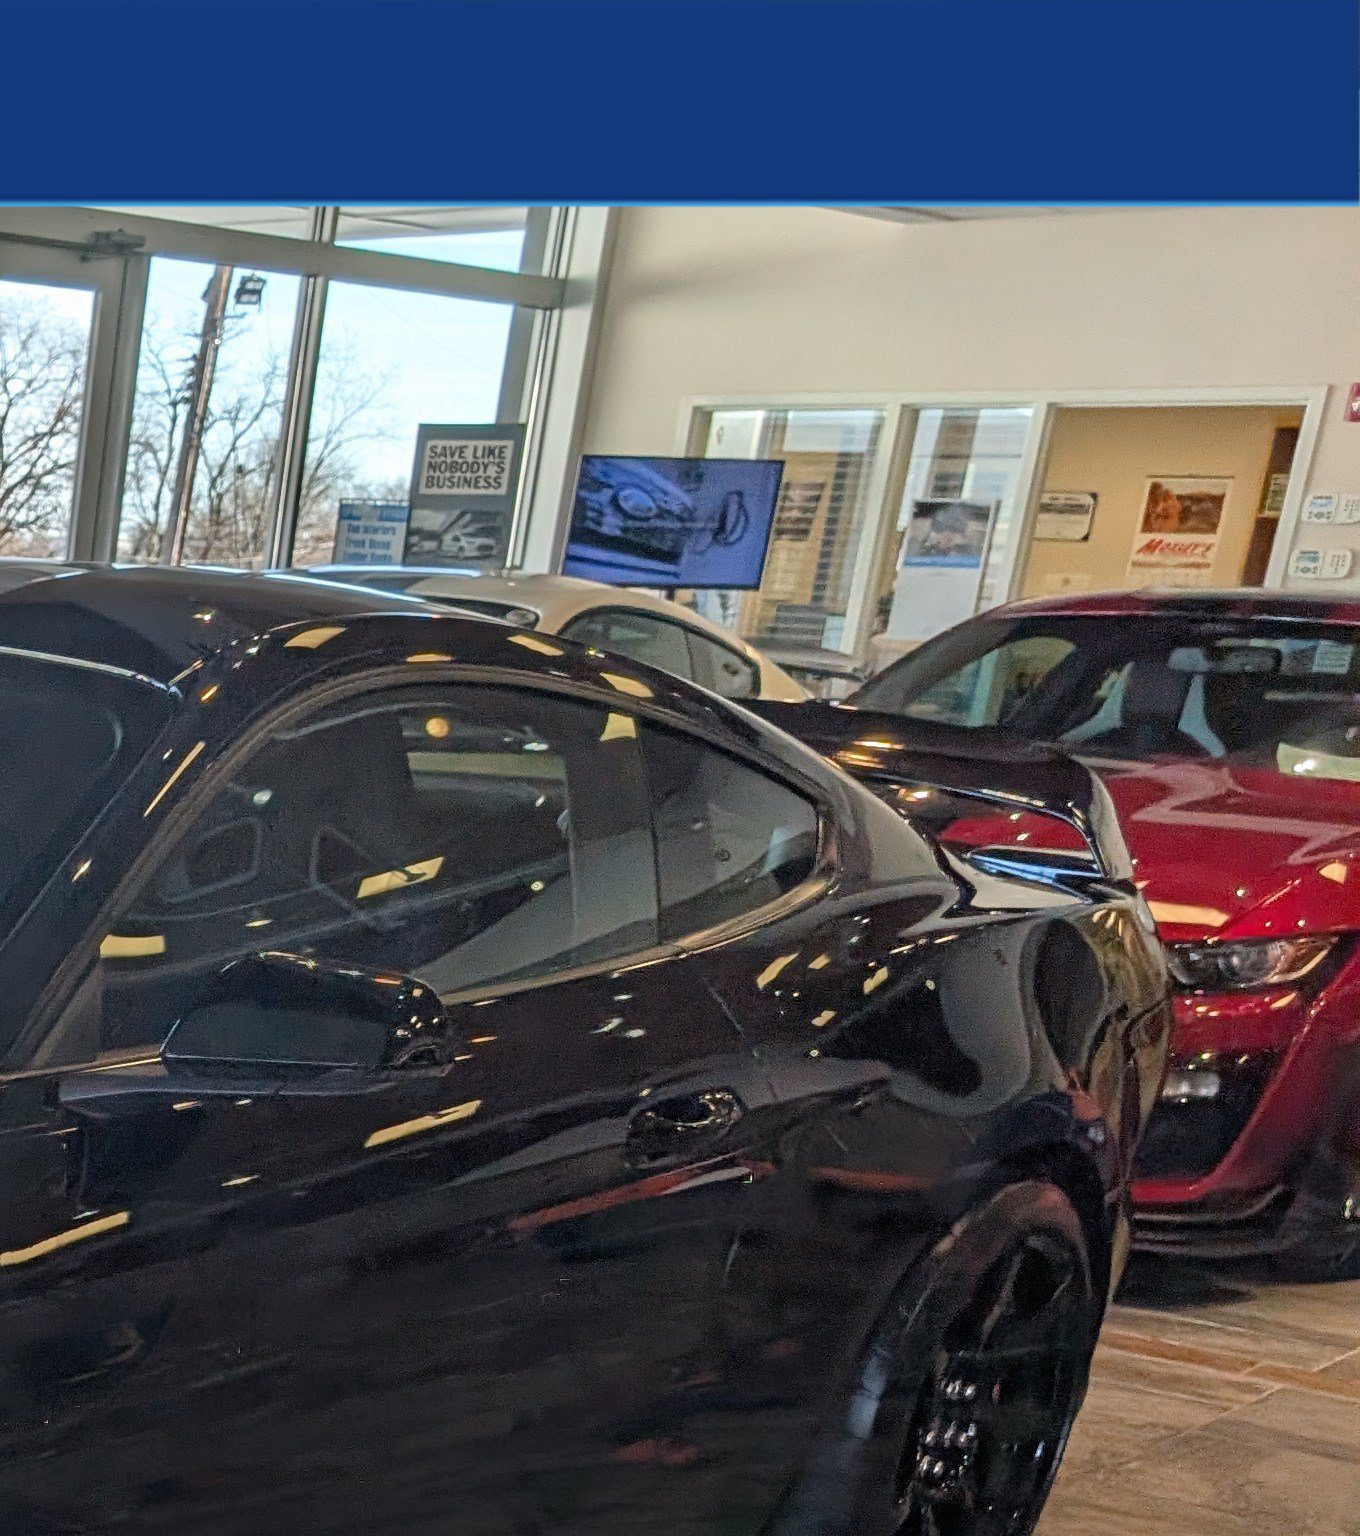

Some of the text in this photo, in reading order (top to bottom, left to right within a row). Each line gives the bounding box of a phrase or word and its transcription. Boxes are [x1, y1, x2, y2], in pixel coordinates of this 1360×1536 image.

[428, 444, 507, 459] SAVE LIKE
[427, 460, 506, 474] NOBODY'S
[425, 475, 502, 489] BUSINESS
